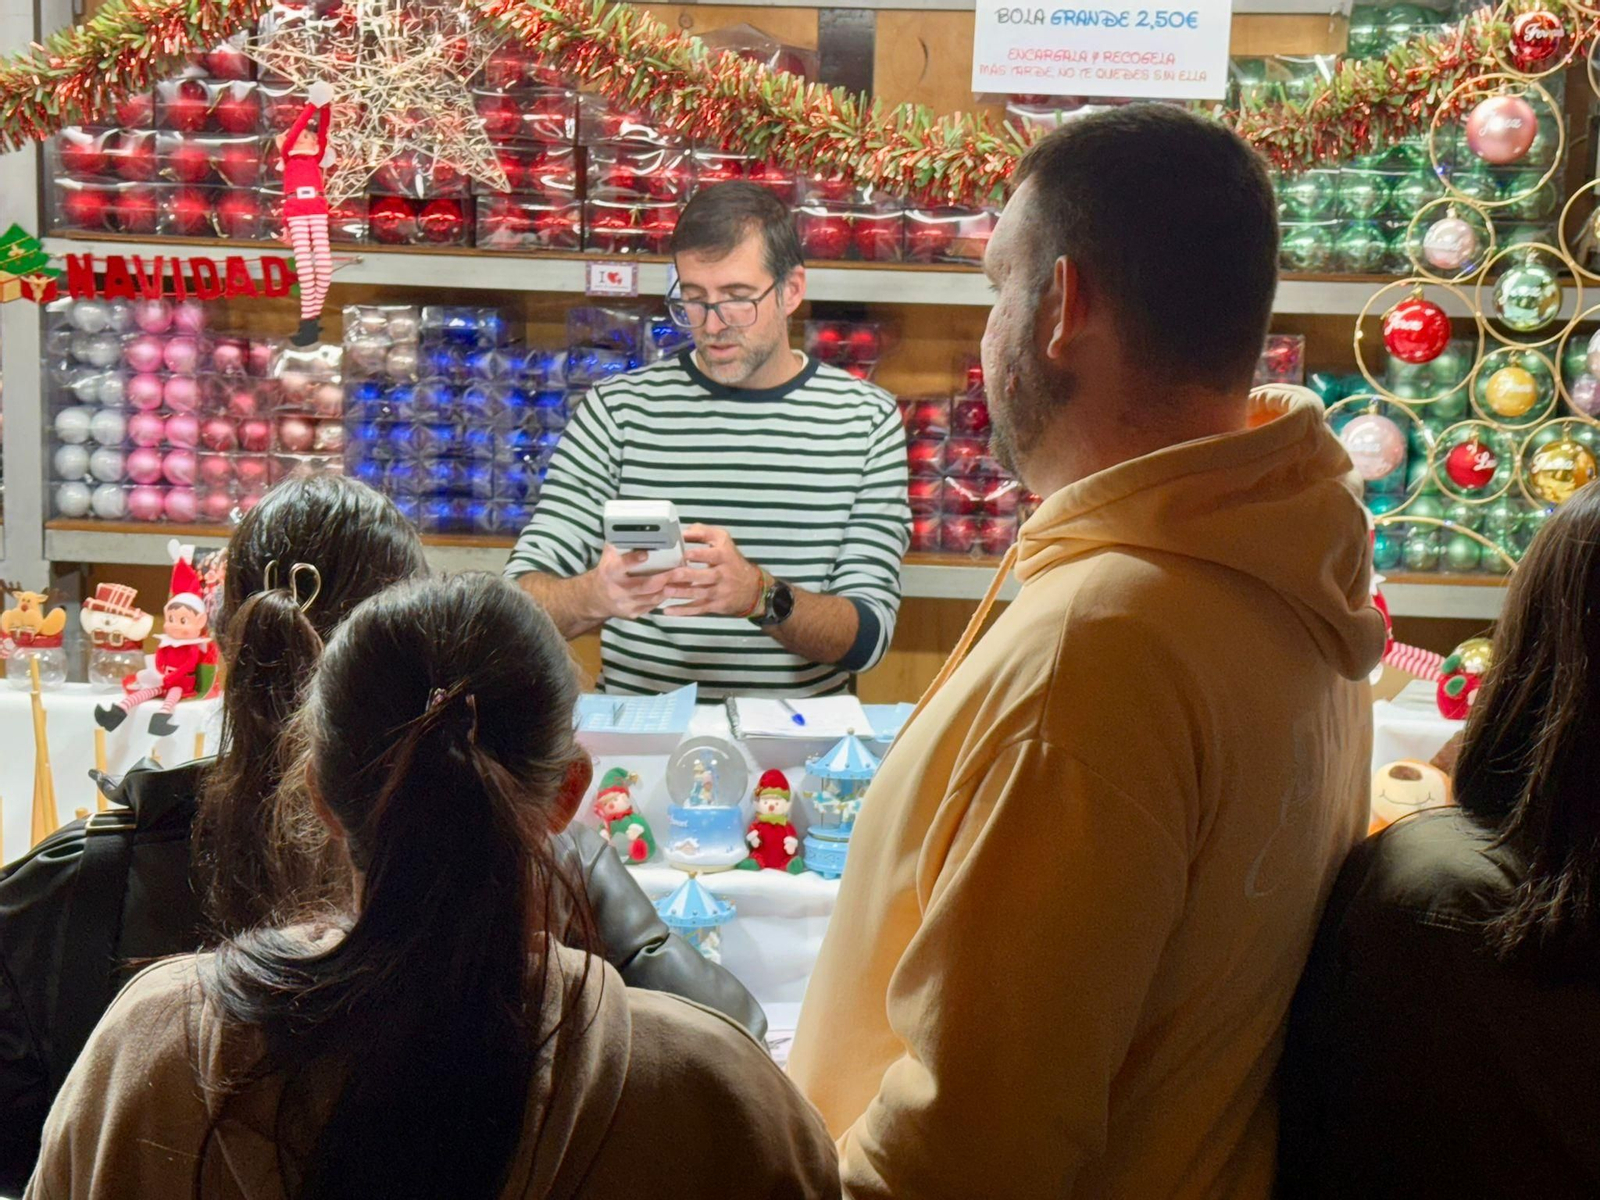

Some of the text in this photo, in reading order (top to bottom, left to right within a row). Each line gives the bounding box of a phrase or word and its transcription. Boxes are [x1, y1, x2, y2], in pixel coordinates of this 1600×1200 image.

[994, 7, 1199, 31] BOLA GRANDE 2,50€
[1058, 67, 1075, 79] NO
[1080, 67, 1092, 79] TE
[1095, 68, 1149, 81] QUEDES
[1153, 69, 1175, 81] SIN
[1178, 70, 1208, 82] ELLA
[66, 253, 290, 302] NAVIDAD
